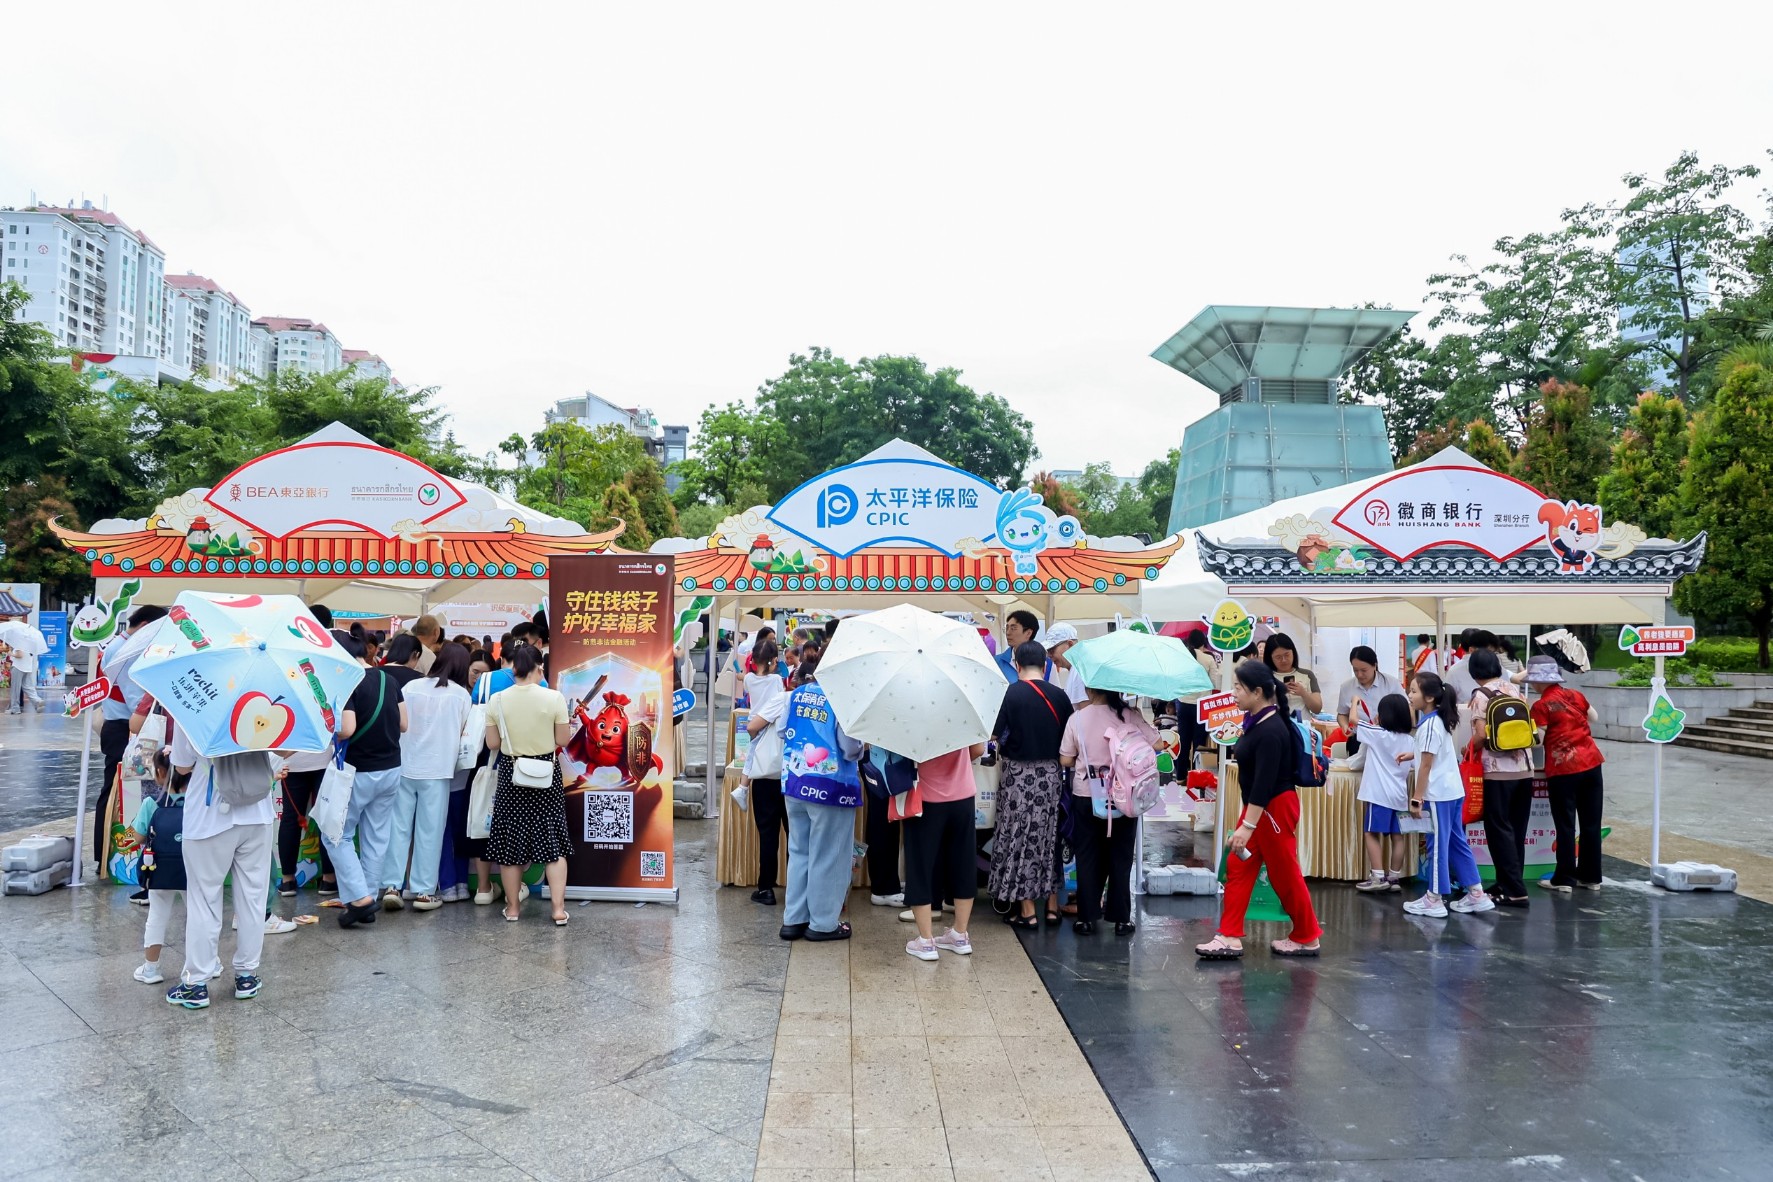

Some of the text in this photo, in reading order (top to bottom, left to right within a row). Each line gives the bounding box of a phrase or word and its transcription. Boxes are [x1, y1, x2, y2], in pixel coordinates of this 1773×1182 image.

[246, 486, 329, 498] BEA 東亞銀行
[866, 488, 979, 509] 太平洋保险
[866, 512, 910, 526] CPIC
[1397, 502, 1483, 521] 徽商银行
[1493, 514, 1530, 523] 深圳分行
[565, 590, 659, 612] 守住钱袋子
[561, 612, 658, 634] 护好幸福家
[582, 638, 637, 646] 防范非法金融活动
[1637, 642, 1680, 652] 高利息是陷阱
[188, 668, 219, 701] rockit
[635, 736, 647, 766] 防非
[800, 785, 828, 800] CPIC
[839, 795, 857, 805] CPIC
